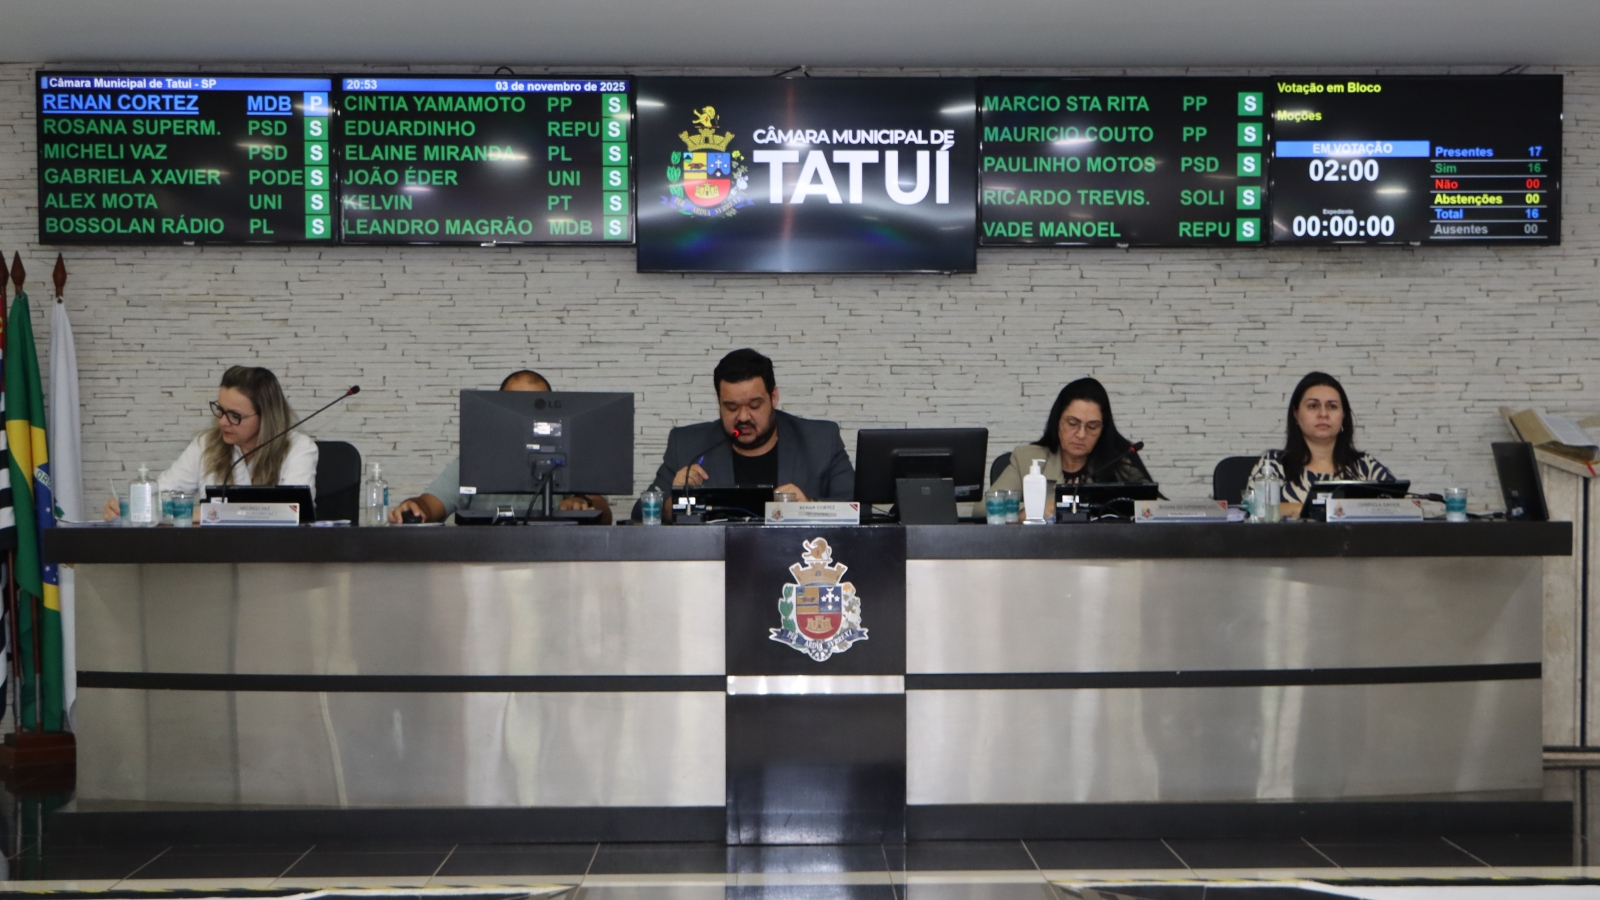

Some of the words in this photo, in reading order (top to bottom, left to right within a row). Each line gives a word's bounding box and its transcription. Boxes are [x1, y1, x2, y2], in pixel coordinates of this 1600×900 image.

[49, 77, 91, 89] Câmara
[93, 78, 147, 90] Municipal
[149, 79, 163, 89] de
[201, 79, 217, 89] SP
[346, 79, 378, 90] 20:53
[495, 81, 509, 91] 03
[510, 82, 525, 91] de
[527, 82, 582, 92] novembro
[583, 82, 598, 92] de
[600, 82, 626, 92] 2025
[1277, 82, 1324, 95] Votação
[1326, 85, 1345, 93] em
[1347, 82, 1381, 93] Bloco
[43, 94, 113, 111] RENAN
[117, 94, 199, 111] CORTEZ
[247, 96, 292, 112] MDB
[310, 96, 322, 112] P
[344, 96, 408, 112] CINTIA
[413, 96, 526, 112] YAMAMOTO
[547, 97, 572, 112] PP
[608, 97, 621, 113] S
[984, 96, 1061, 112] MARCIO
[1066, 96, 1102, 112] STA
[1107, 96, 1149, 111] RITA
[1183, 96, 1208, 111] PP
[1244, 96, 1257, 112] S
[1277, 110, 1322, 123] Moções
[43, 119, 127, 136] ROSANA
[132, 119, 222, 136] SUPERM.
[248, 120, 287, 136] PSD
[309, 120, 323, 136] S
[344, 120, 475, 137] EDUARDINHO
[547, 121, 600, 137] REPU
[608, 121, 621, 137] S
[752, 125, 830, 145] CÂMARA
[832, 129, 927, 145] MUNICIPAL
[930, 129, 955, 145] DE
[984, 126, 1079, 142] MAURICIO
[1085, 126, 1154, 142] COUTO
[1182, 127, 1207, 142] PP
[1244, 127, 1256, 142] S
[44, 144, 125, 159] MICHELI
[129, 144, 168, 160] VAZ
[248, 145, 288, 161] PSD
[310, 145, 323, 161] S
[345, 145, 417, 161] ELAINE
[423, 145, 516, 161] MIRANDA
[548, 146, 572, 161] PL
[609, 146, 622, 162] S
[1312, 144, 1331, 154] EM
[1333, 140, 1393, 156] VOTAÇÃO
[1435, 146, 1493, 158] Presentes
[1528, 146, 1542, 157] 17
[984, 157, 1081, 172] PAULINHO
[1086, 157, 1156, 172] MOTOS
[1181, 157, 1219, 172] PSD
[1243, 157, 1255, 172] S
[1308, 159, 1379, 182] 02:00
[1434, 163, 1457, 174] Sim
[1527, 163, 1542, 173] 16
[44, 168, 146, 185] GABRIELA
[150, 169, 221, 185] XAVIER
[249, 169, 303, 185] PODE
[310, 170, 324, 186] S
[343, 167, 399, 186] JOÃO
[405, 166, 458, 186] ÉDER
[548, 170, 580, 186] UNI
[609, 170, 622, 186] S
[752, 142, 955, 205] TATUÍ
[1434, 178, 1458, 190] Não
[1525, 179, 1540, 189] 00
[45, 193, 96, 209] ALEX
[102, 193, 158, 209] MOTA
[249, 194, 282, 210] UNI
[311, 194, 324, 211] S
[344, 194, 413, 210] KELVIN
[548, 195, 572, 211] PT
[609, 195, 622, 211] S
[983, 190, 1071, 206] RICARDO
[1076, 190, 1150, 206] TREVIS.
[1180, 189, 1224, 206] SOLI
[1242, 190, 1255, 206] S
[1434, 193, 1503, 207] Abstenções
[1525, 193, 1540, 204] 00
[1322, 208, 1354, 216] Expediente
[1434, 208, 1464, 219] Total
[1525, 208, 1539, 219] 16
[45, 218, 155, 234] BOSSOLAN
[162, 215, 225, 234] RÁDIO
[249, 218, 274, 234] PL
[311, 219, 325, 235] S
[345, 219, 439, 235] LEANDRO
[445, 216, 533, 235] MAGRÃO
[549, 219, 593, 235] MDB
[609, 220, 622, 236] S
[983, 221, 1033, 237] VADE
[1039, 221, 1121, 237] MANOEL
[1179, 221, 1230, 237] REPU
[1242, 221, 1254, 237] S
[1292, 215, 1395, 237] 00:00:00
[1434, 224, 1488, 235] Ausentes
[1524, 224, 1539, 234] 00
[548, 400, 562, 409] LG
